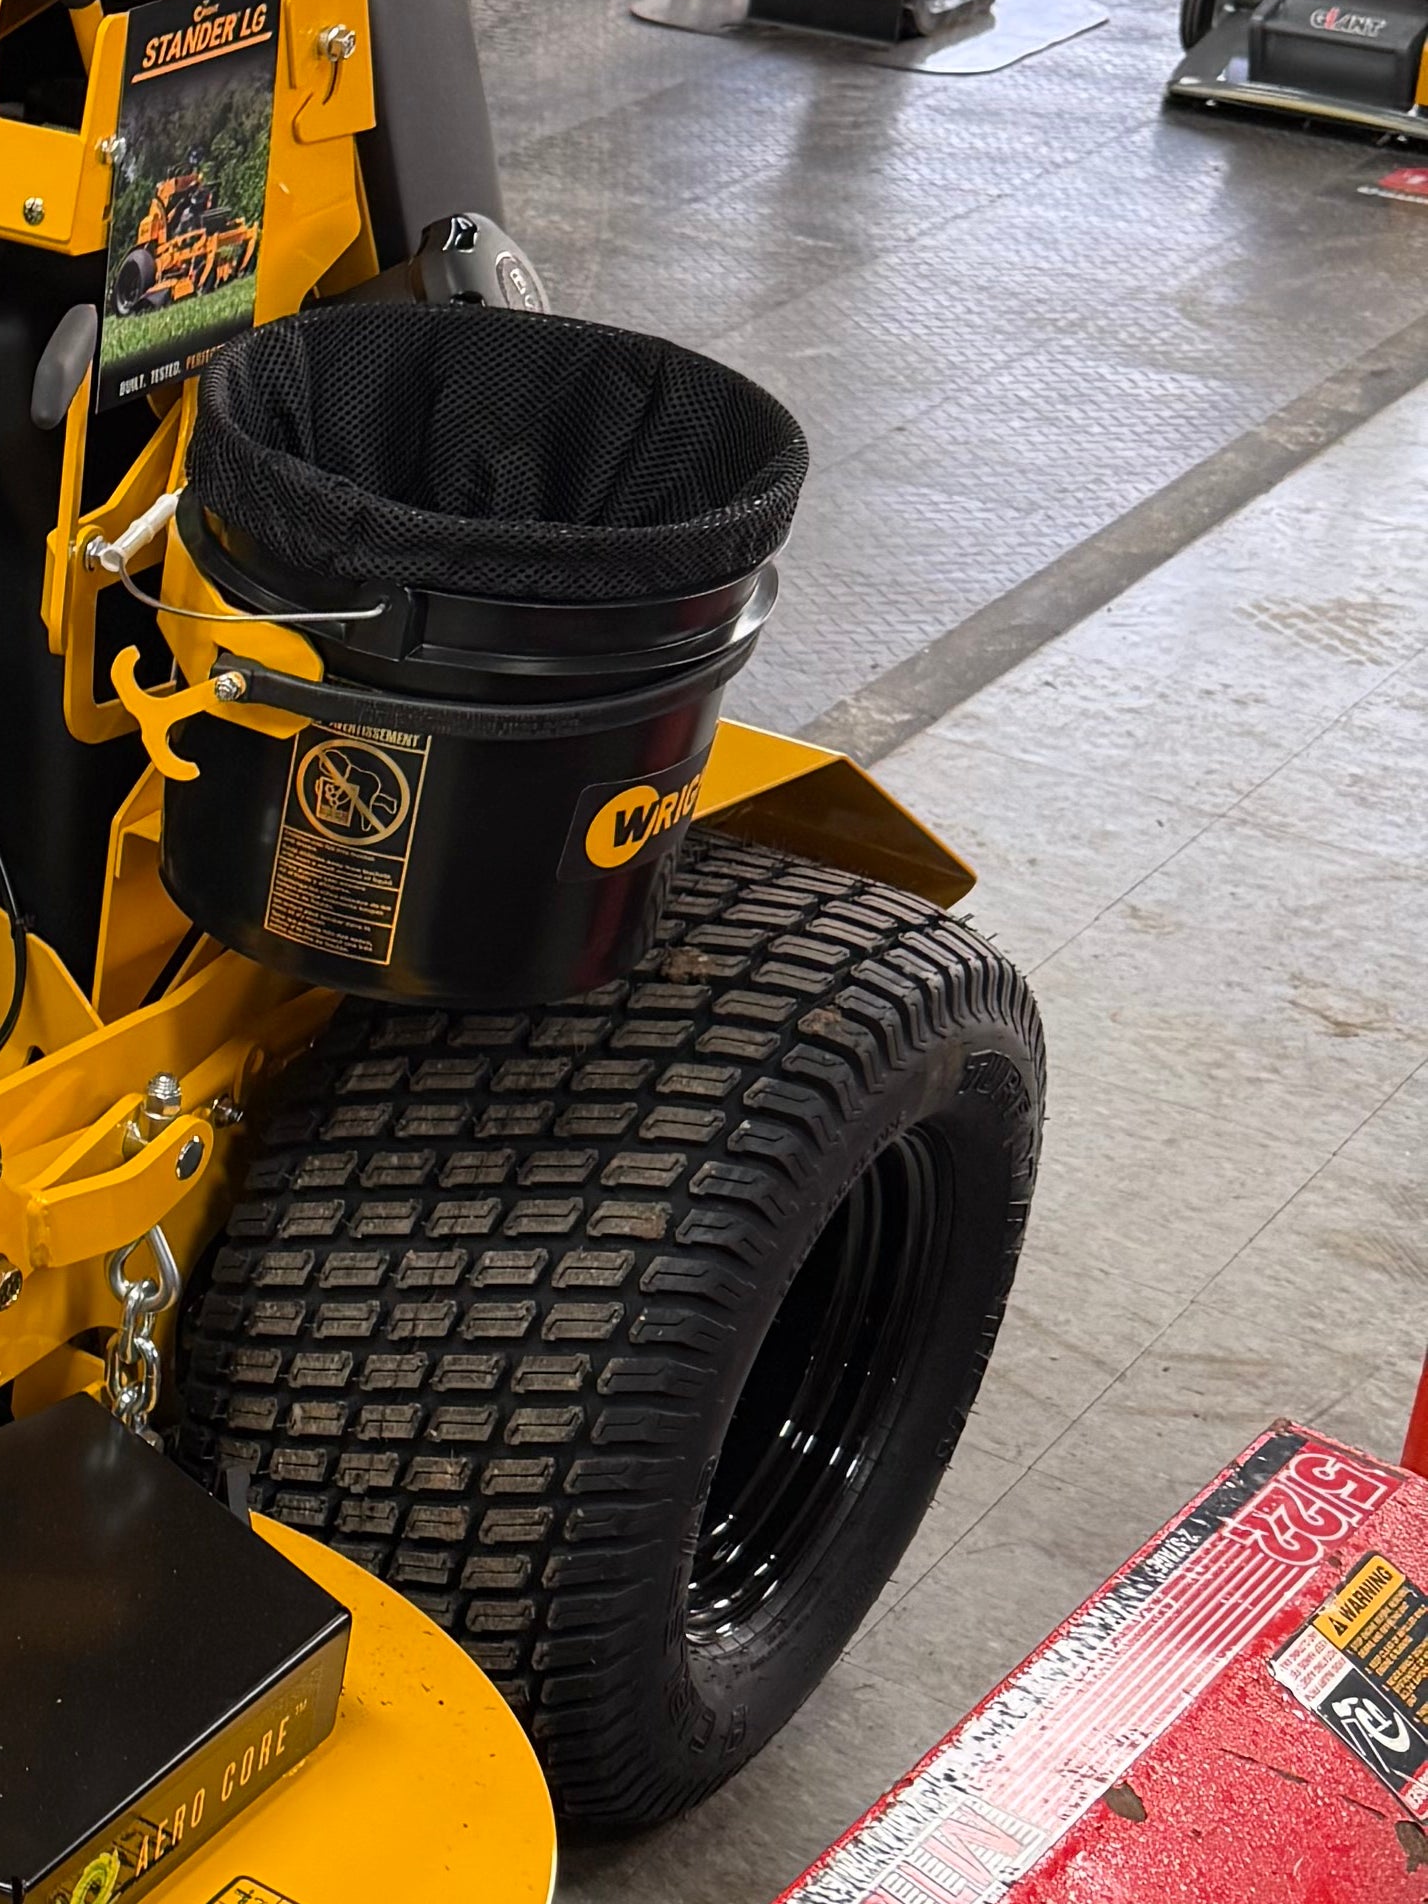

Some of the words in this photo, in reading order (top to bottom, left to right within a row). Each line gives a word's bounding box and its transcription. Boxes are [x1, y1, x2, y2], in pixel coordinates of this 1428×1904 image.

[239, 2, 268, 38] LG
[119, 374, 147, 397] BUILT.
[150, 360, 182, 385] TESTED.
[611, 773, 701, 849] WRIG
[1339, 1564, 1394, 1624] WARNING
[135, 1787, 206, 1878] AERO
